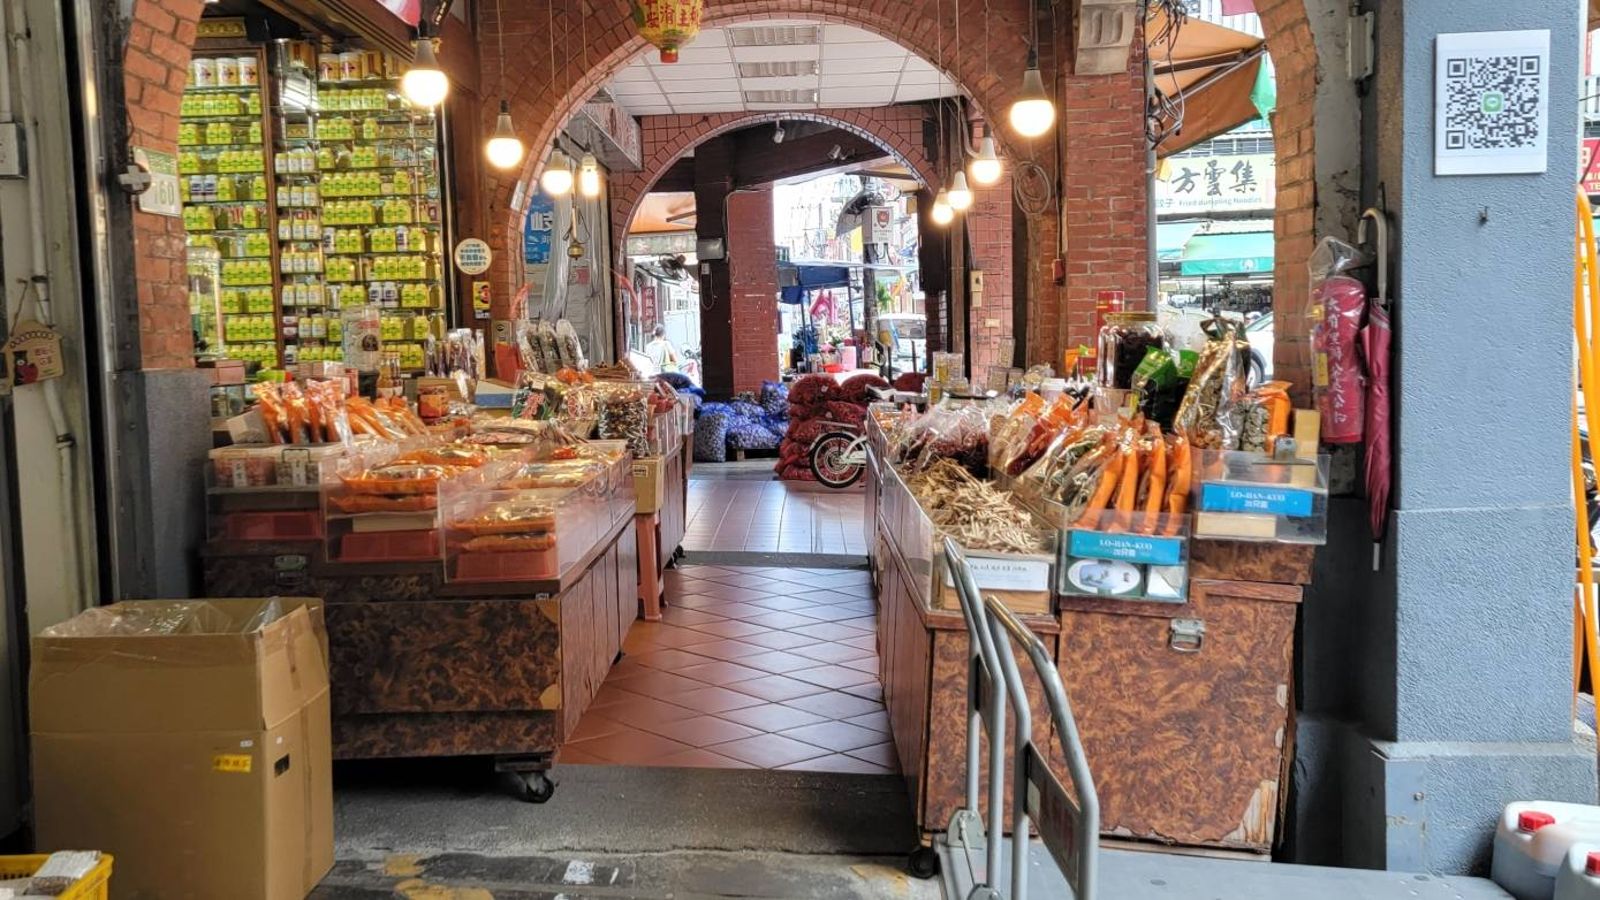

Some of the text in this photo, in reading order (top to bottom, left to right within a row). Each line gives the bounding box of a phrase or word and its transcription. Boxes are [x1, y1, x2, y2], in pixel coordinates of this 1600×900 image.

[1171, 159, 1257, 196] 方雲集
[1179, 199, 1197, 207] Fried
[1100, 539, 1152, 550] LO-HAN-KUO
